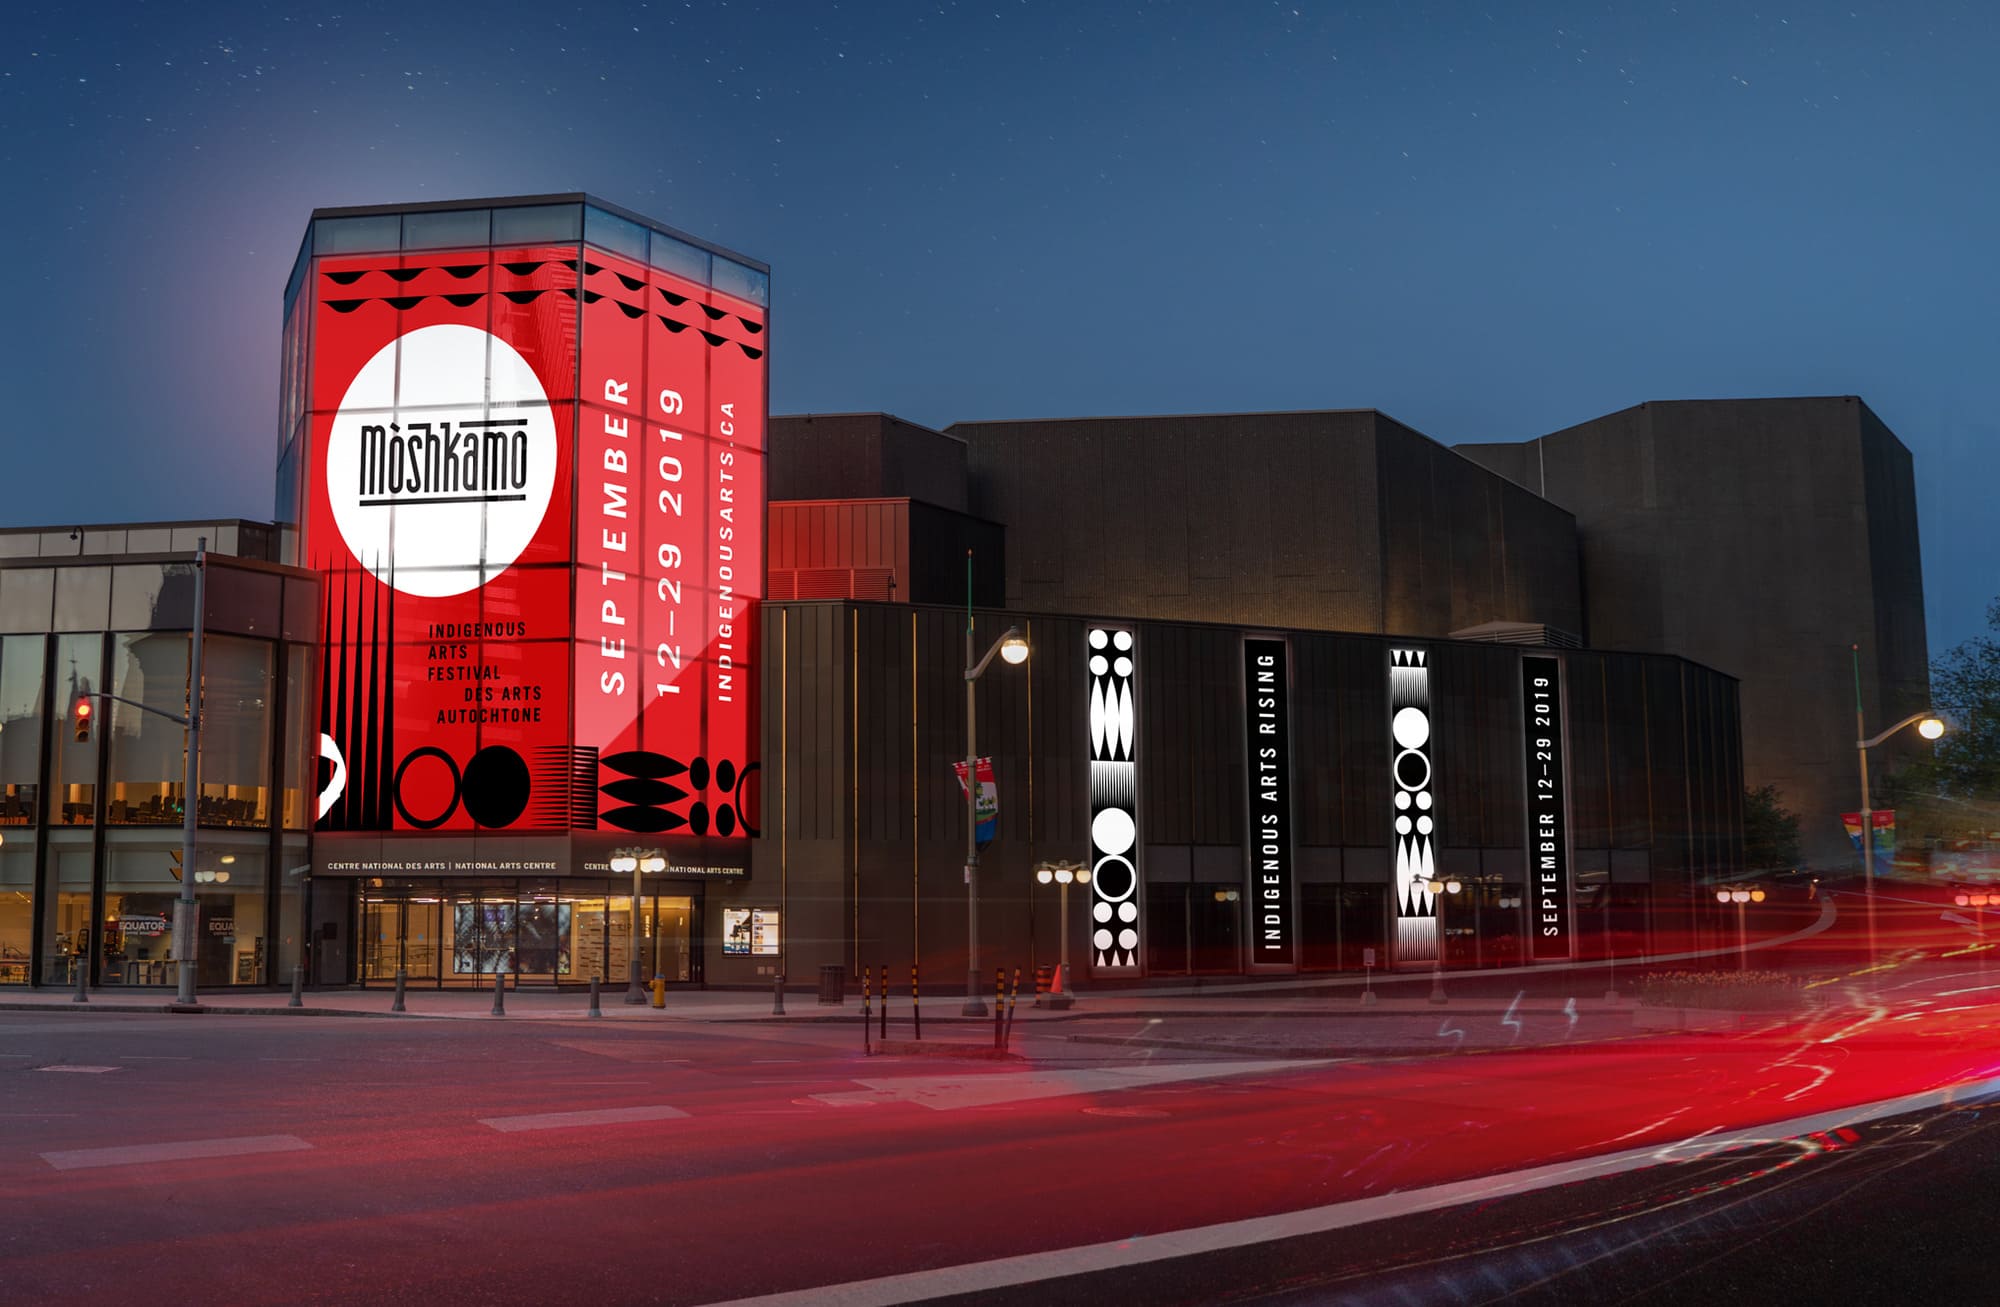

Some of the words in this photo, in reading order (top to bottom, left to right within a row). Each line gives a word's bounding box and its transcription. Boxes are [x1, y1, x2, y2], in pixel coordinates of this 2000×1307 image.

[658, 389, 683, 517] 2019
[600, 378, 628, 696] SEPTEMBER
[718, 403, 734, 702] INDIGENOUSARTS.CA
[428, 621, 526, 638] INDIGENOUS
[428, 644, 468, 660] ARTS
[428, 665, 501, 681] FESTIVAL
[464, 687, 493, 702] DES
[502, 685, 542, 701] ARTS
[1257, 655, 1276, 735] RISING
[1533, 677, 1550, 727] 2019
[437, 707, 541, 724] AUTOCHTONE
[1259, 748, 1278, 802] ARTS
[327, 862, 360, 870] CENTRE
[362, 862, 403, 870] NATIONAL
[405, 862, 422, 870] DES
[424, 862, 446, 870] ARTS
[455, 862, 497, 870] NATIONAL
[500, 862, 521, 870] ARTS
[523, 862, 556, 870] CENTRE
[584, 863, 609, 871] CENTRE
[669, 866, 705, 874] NATIONAL
[706, 867, 721, 875] ARTS
[722, 867, 744, 875] CENTRE
[1261, 814, 1281, 949] INDIGENOUS
[1539, 814, 1559, 936] SEPTEMBER
[119, 921, 165, 931] EQUATOR
